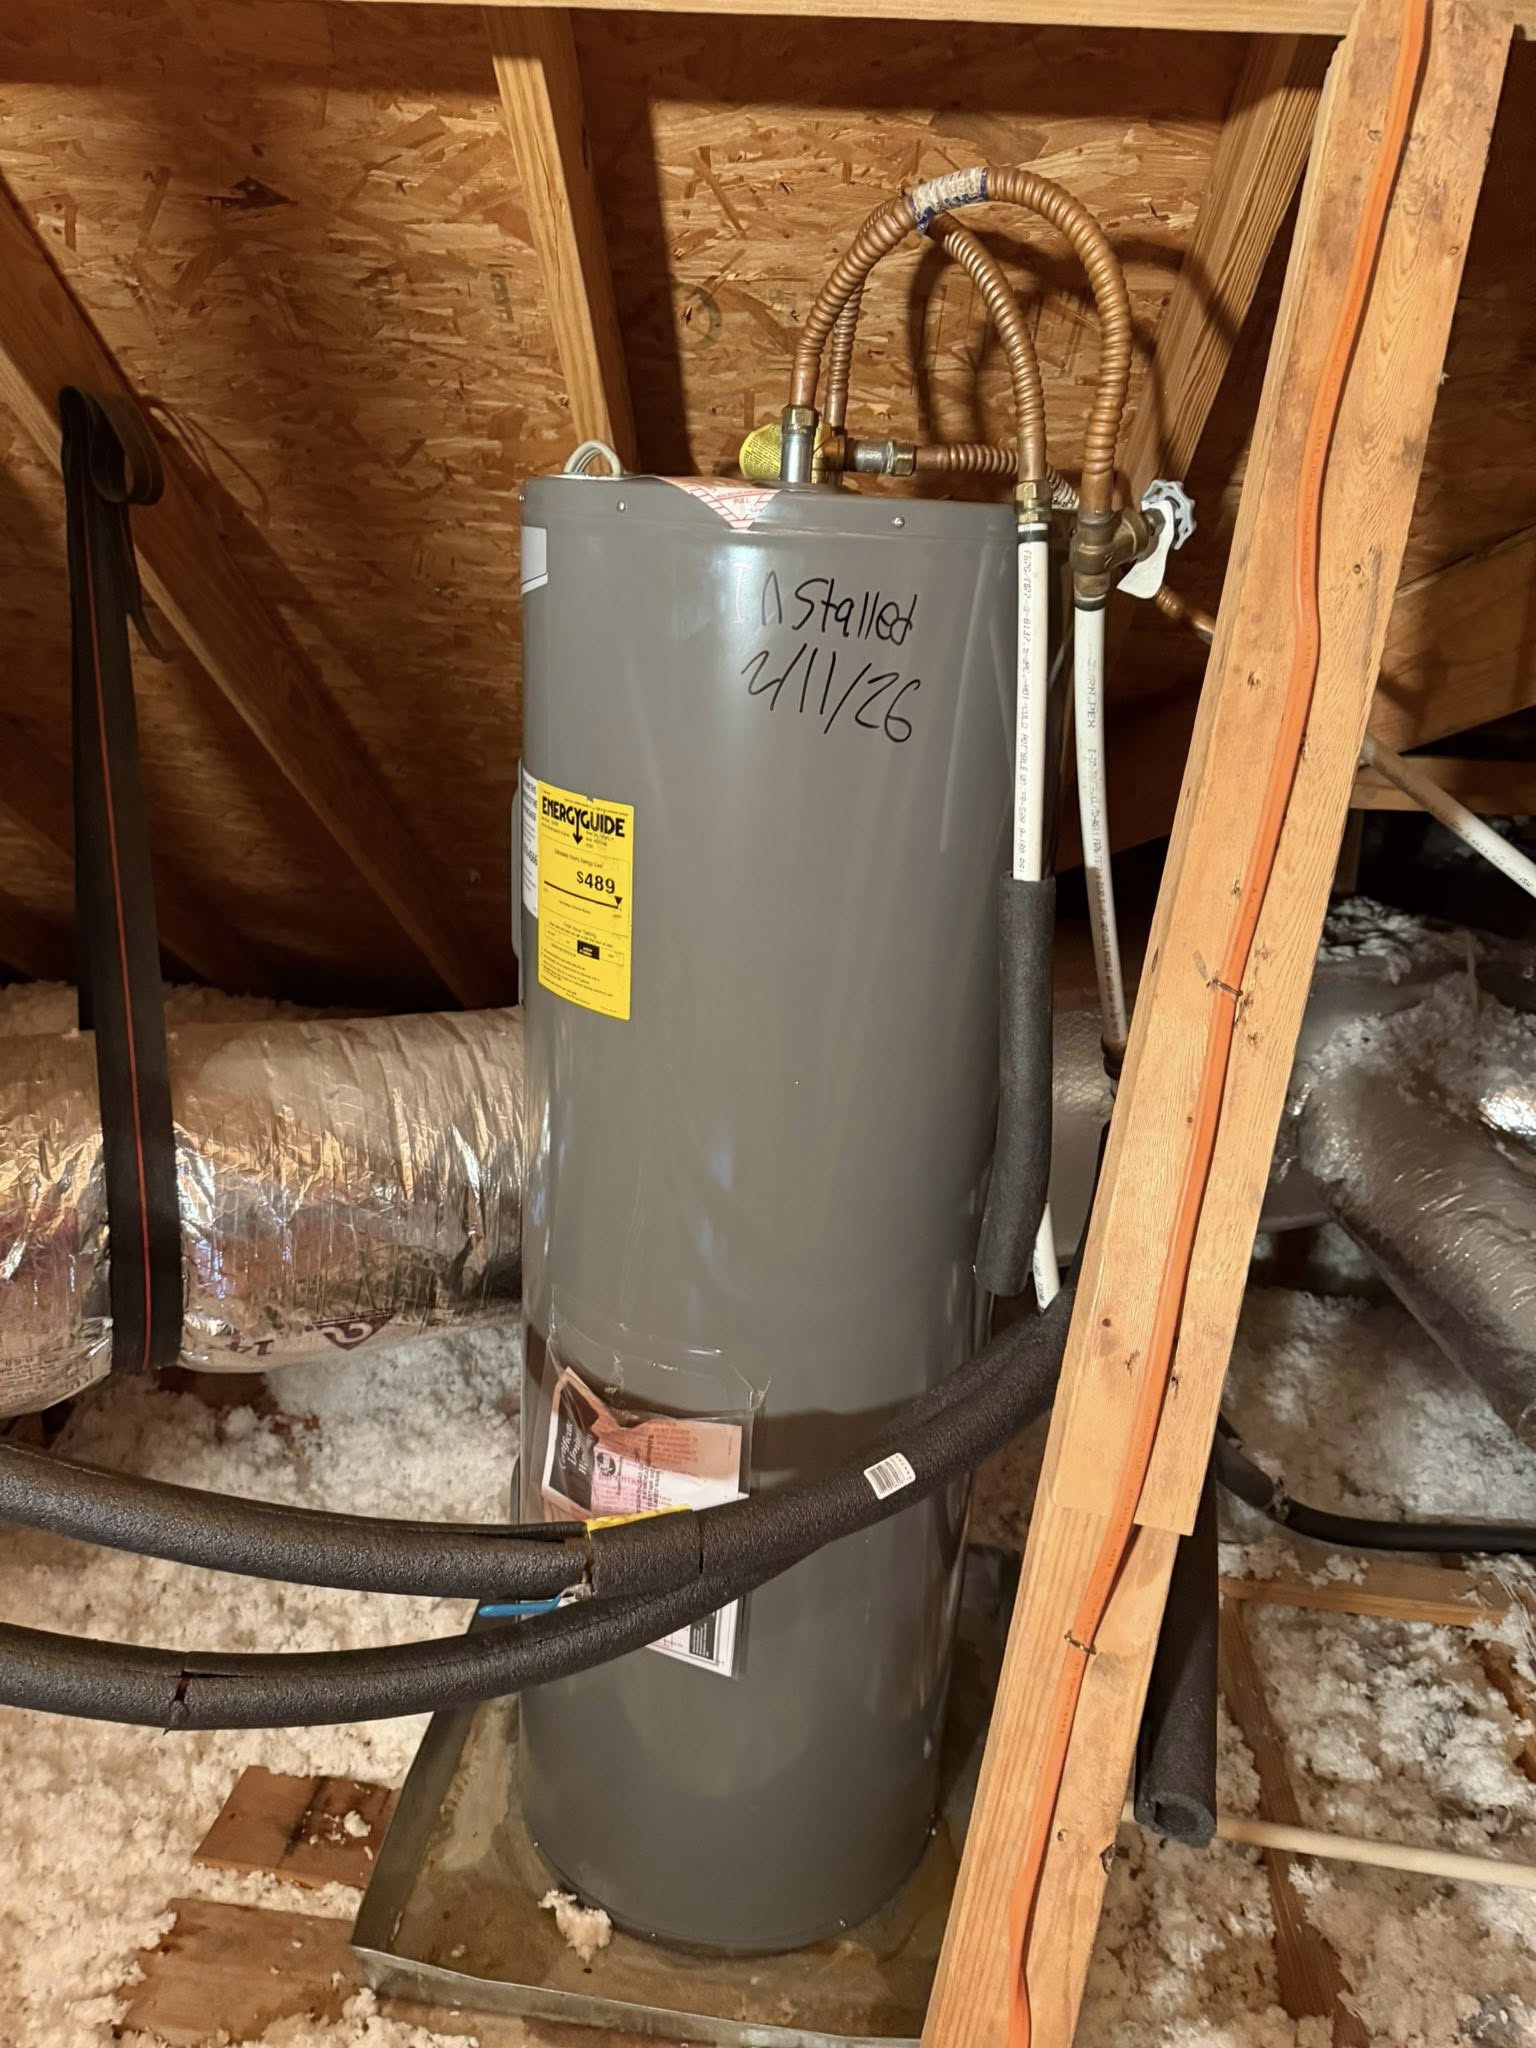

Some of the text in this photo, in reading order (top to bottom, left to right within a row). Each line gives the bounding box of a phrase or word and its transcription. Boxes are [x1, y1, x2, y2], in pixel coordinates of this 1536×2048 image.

[740, 642, 921, 743] 2/11/26
[1086, 699, 1098, 729] PEX
[542, 795, 626, 838] ENERGYGUIDE
[576, 870, 616, 895] $489
